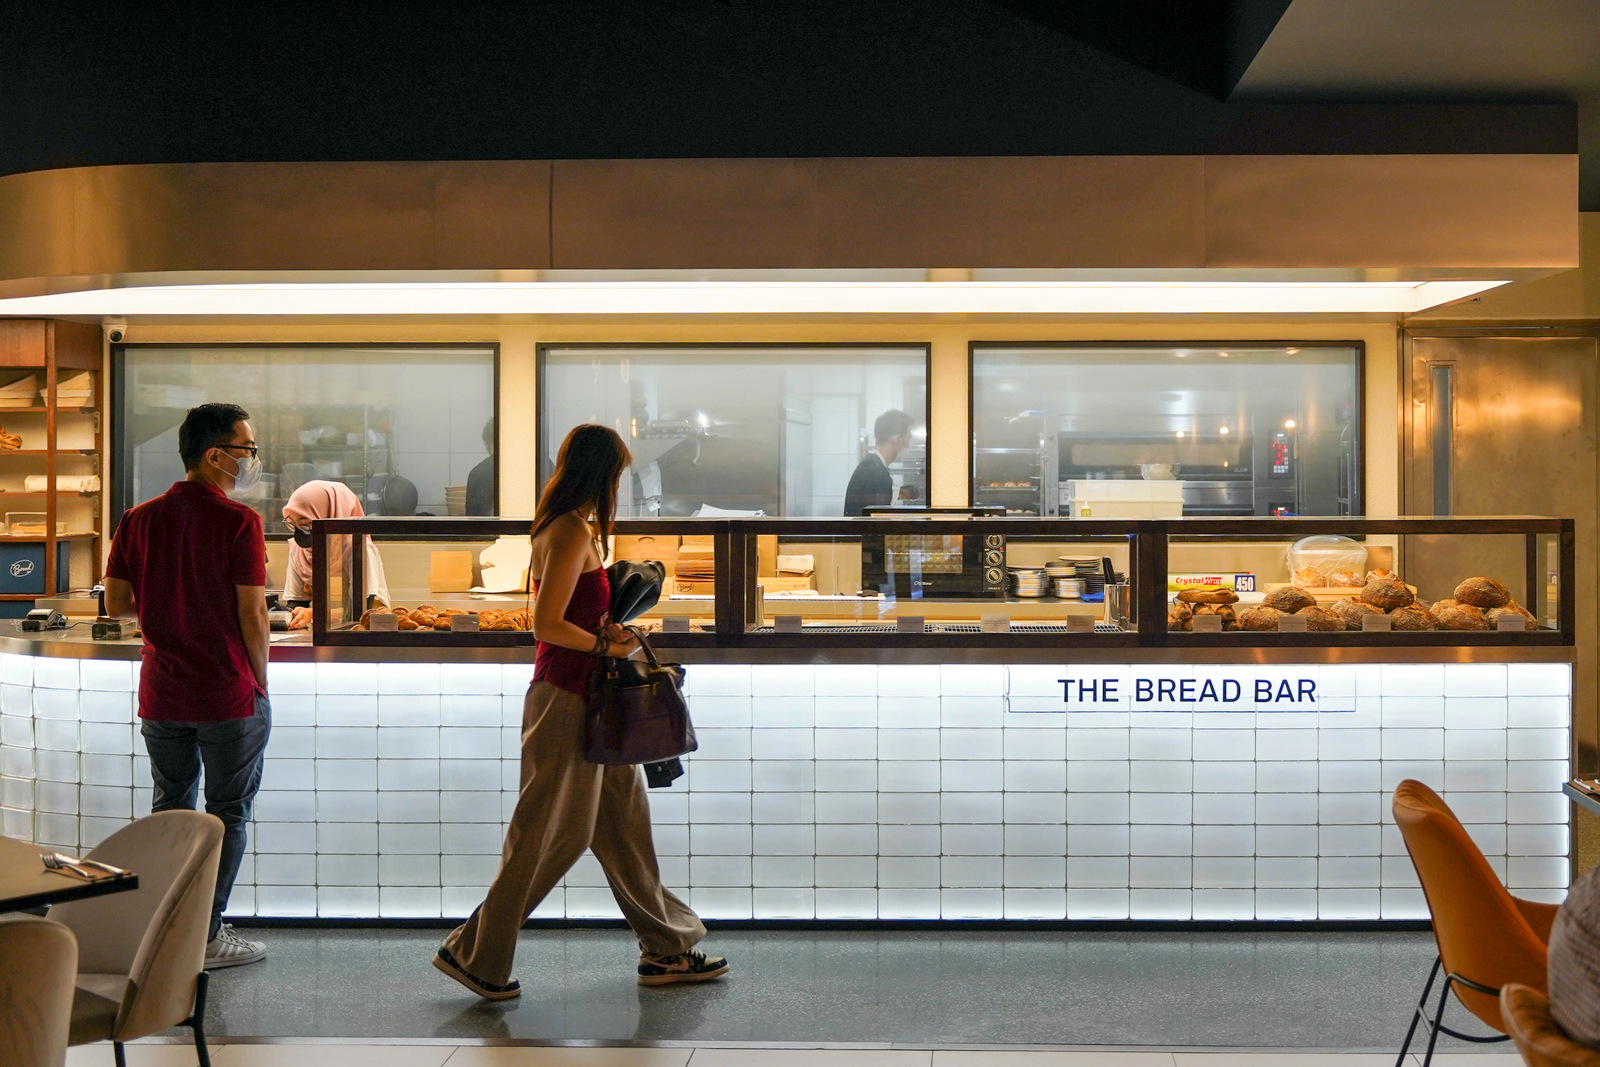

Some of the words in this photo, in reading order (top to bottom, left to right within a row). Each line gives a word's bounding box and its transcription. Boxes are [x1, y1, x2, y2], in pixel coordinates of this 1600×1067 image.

[1236, 576, 1254, 591] 450
[1058, 678, 1119, 702] THE
[1136, 678, 1241, 702] BREAD
[1254, 678, 1316, 702] BAR
